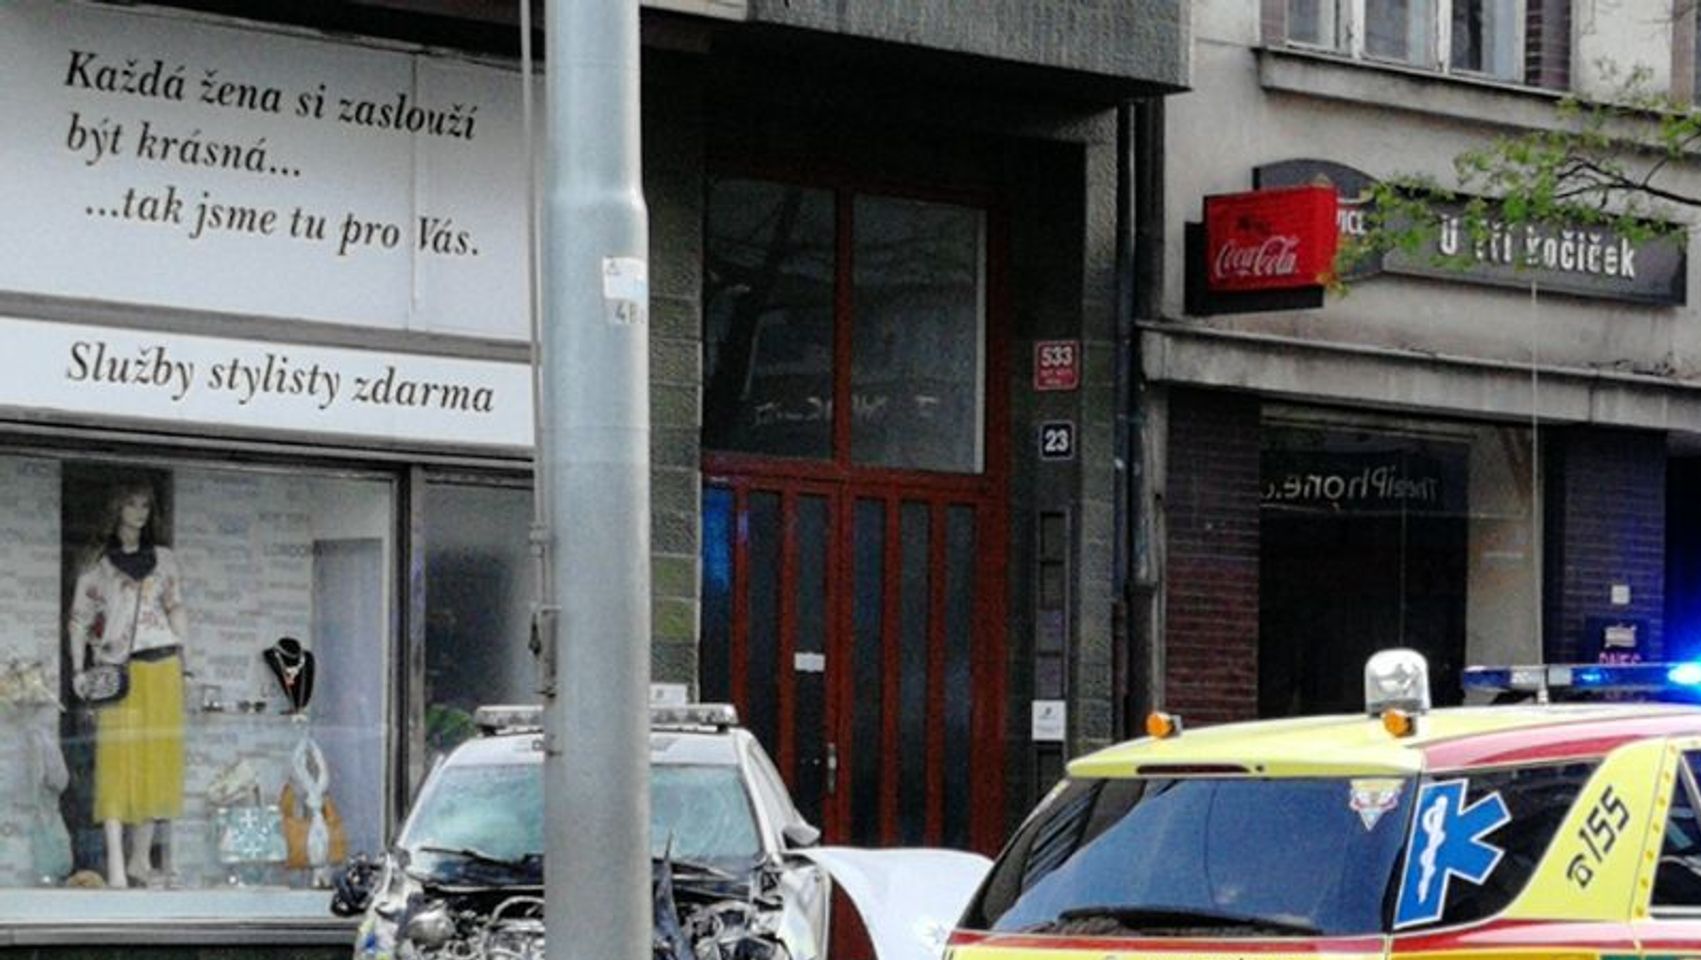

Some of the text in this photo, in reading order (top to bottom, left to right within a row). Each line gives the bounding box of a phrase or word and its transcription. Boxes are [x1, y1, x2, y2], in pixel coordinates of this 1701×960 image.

[64, 49, 479, 141] Každá žena si zaslouží
[66, 113, 302, 177] být krásná...
[84, 186, 481, 257] ...tak jsme tu pro Vás.
[1440, 213, 1459, 256] U
[66, 341, 496, 412] Služby stylisty zdarma
[1041, 346, 1073, 367] 533
[1045, 429, 1069, 452] 23
[1578, 784, 1630, 864] 155
